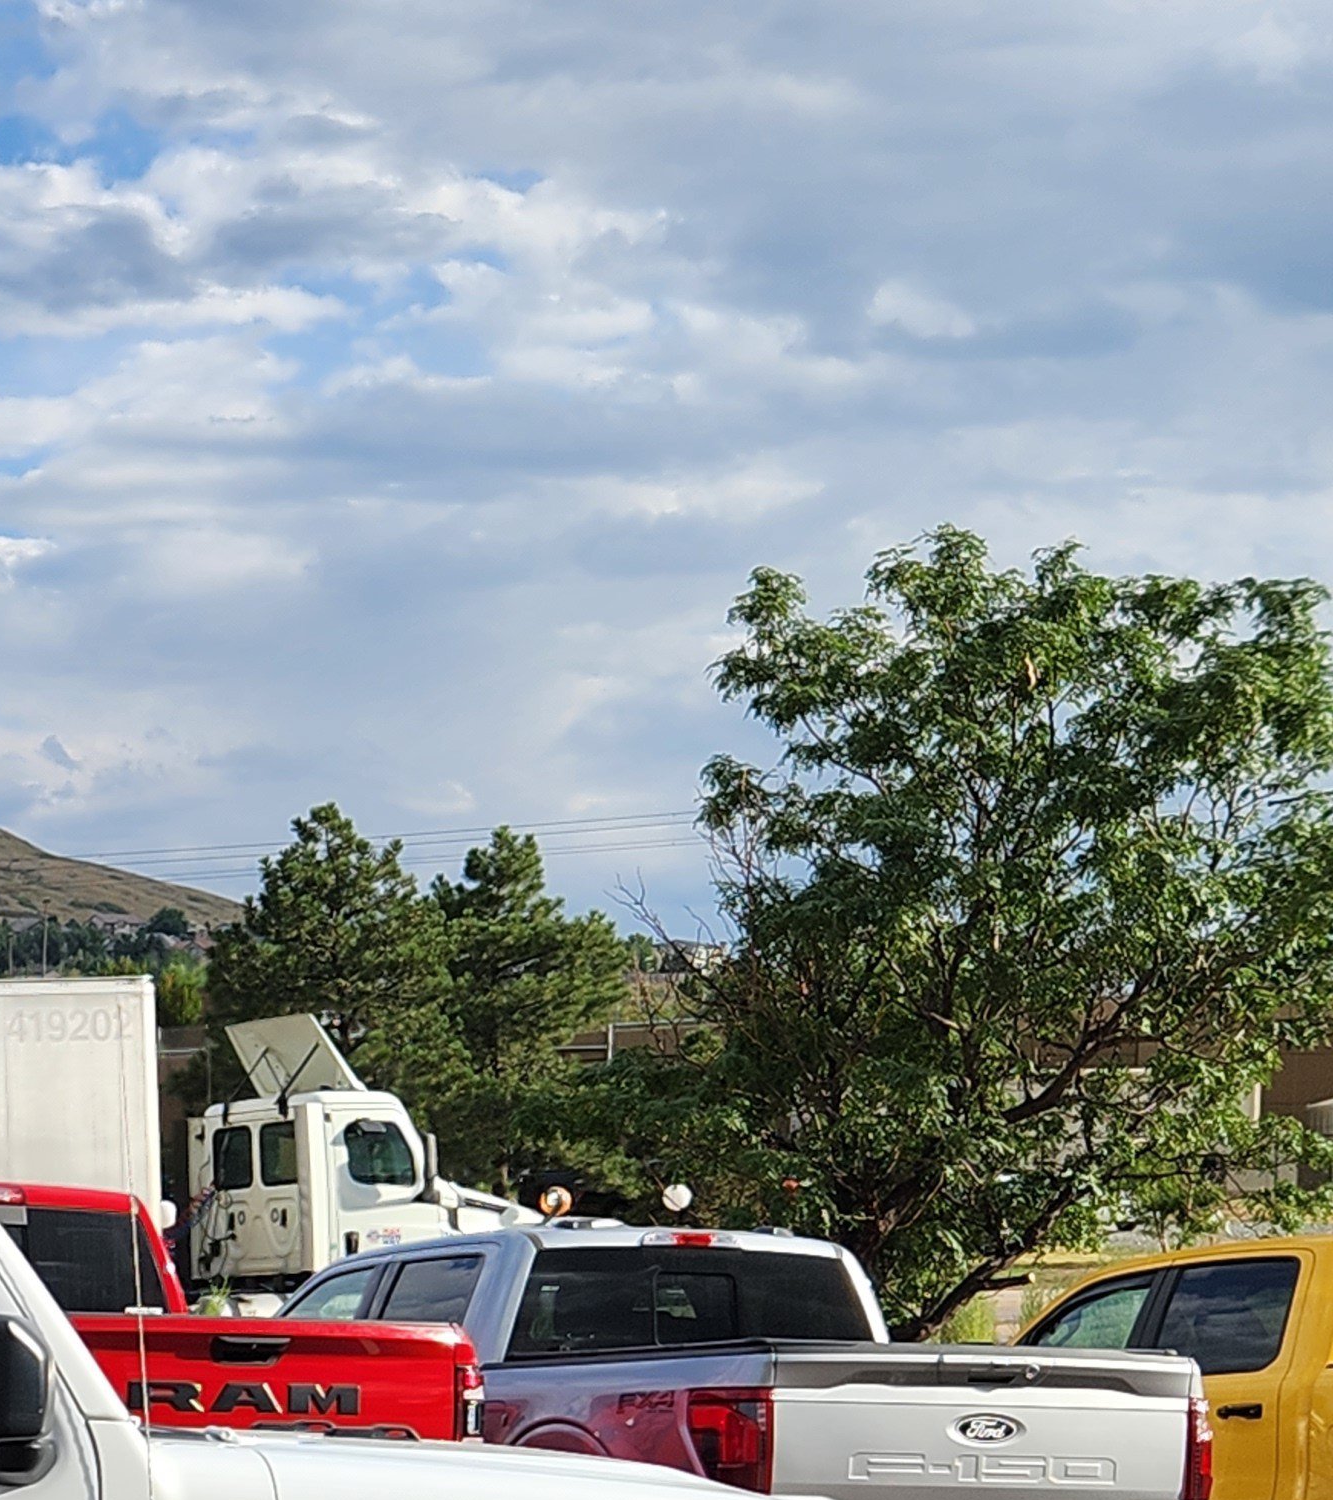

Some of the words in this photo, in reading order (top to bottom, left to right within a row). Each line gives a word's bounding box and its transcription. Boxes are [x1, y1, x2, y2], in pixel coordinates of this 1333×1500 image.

[6, 1007, 133, 1043] 419202
[127, 1380, 361, 1416] RAM
[616, 1390, 675, 1414] FX4
[965, 1419, 1009, 1440] Ford
[848, 1451, 1117, 1486] F-150
